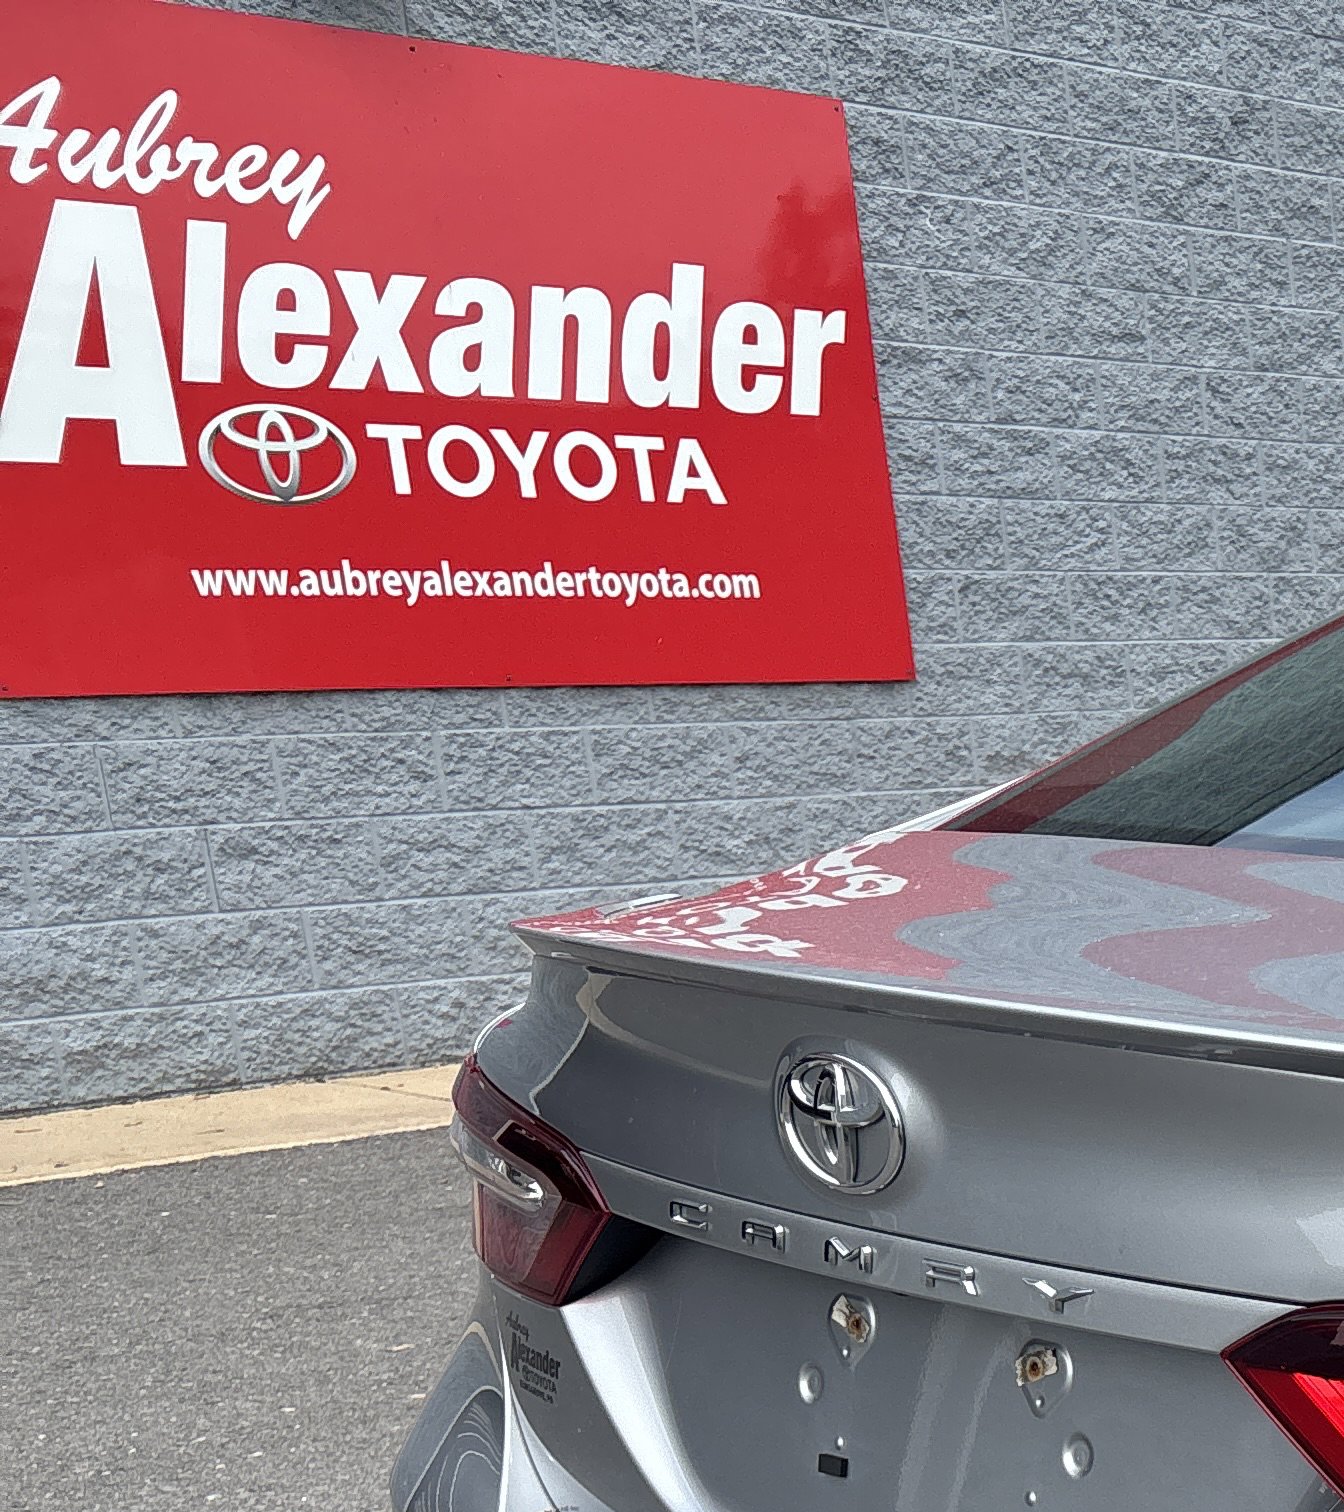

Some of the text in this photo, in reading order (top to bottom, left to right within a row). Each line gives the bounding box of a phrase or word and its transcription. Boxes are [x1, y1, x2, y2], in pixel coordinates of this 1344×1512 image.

[0, 75, 331, 241] Aubrey
[0, 198, 848, 468] Alexander
[367, 423, 729, 506] TOYOTA
[190, 559, 762, 607] www.aubreyalexandertoyota.com
[669, 1200, 1095, 1314] CAMRY
[510, 1331, 561, 1380] Alexander
